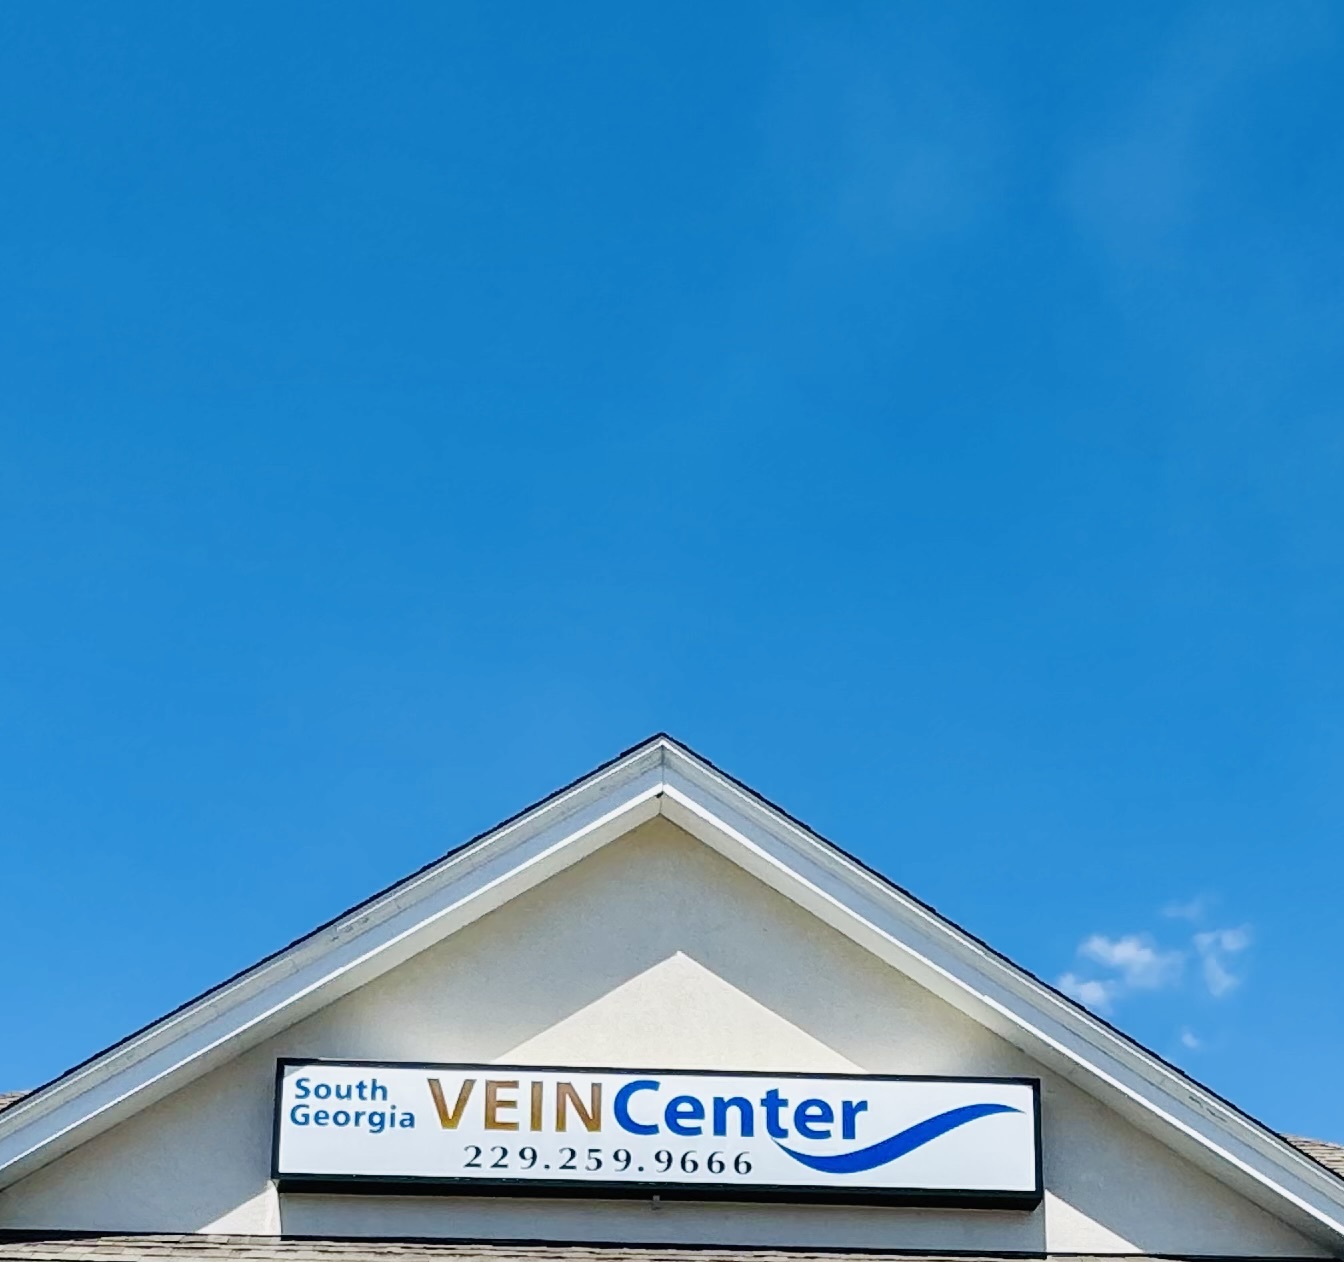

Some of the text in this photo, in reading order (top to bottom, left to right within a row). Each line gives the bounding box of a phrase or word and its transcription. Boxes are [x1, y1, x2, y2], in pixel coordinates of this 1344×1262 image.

[294, 1077, 388, 1101] South
[289, 1103, 416, 1134] Georgia
[427, 1077, 869, 1142] VEIN Center
[463, 1145, 754, 1175] 229.259.9666
